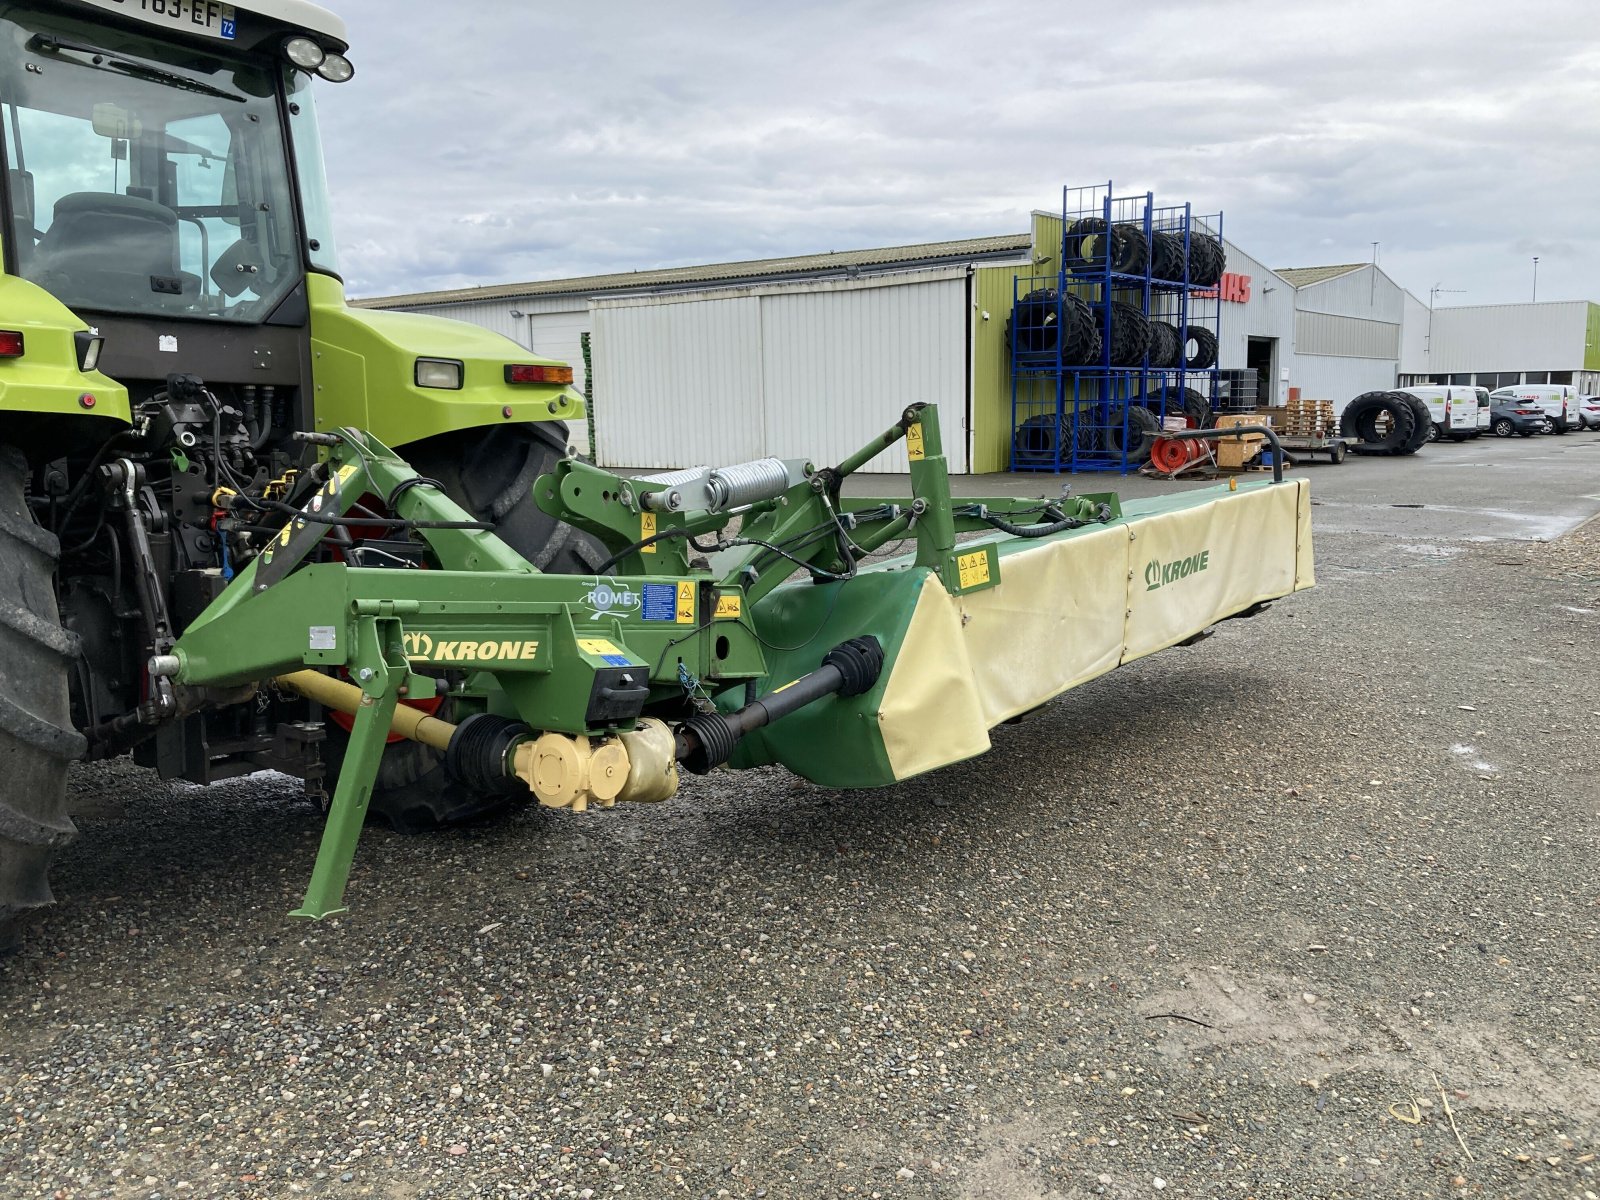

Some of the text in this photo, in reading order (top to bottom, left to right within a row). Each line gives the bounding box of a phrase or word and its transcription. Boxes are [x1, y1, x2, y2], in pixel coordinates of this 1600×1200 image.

[222, 21, 234, 35] 72
[1161, 549, 1209, 586] KRONE
[587, 591, 641, 605] ROMET
[433, 640, 539, 661] KRONE
